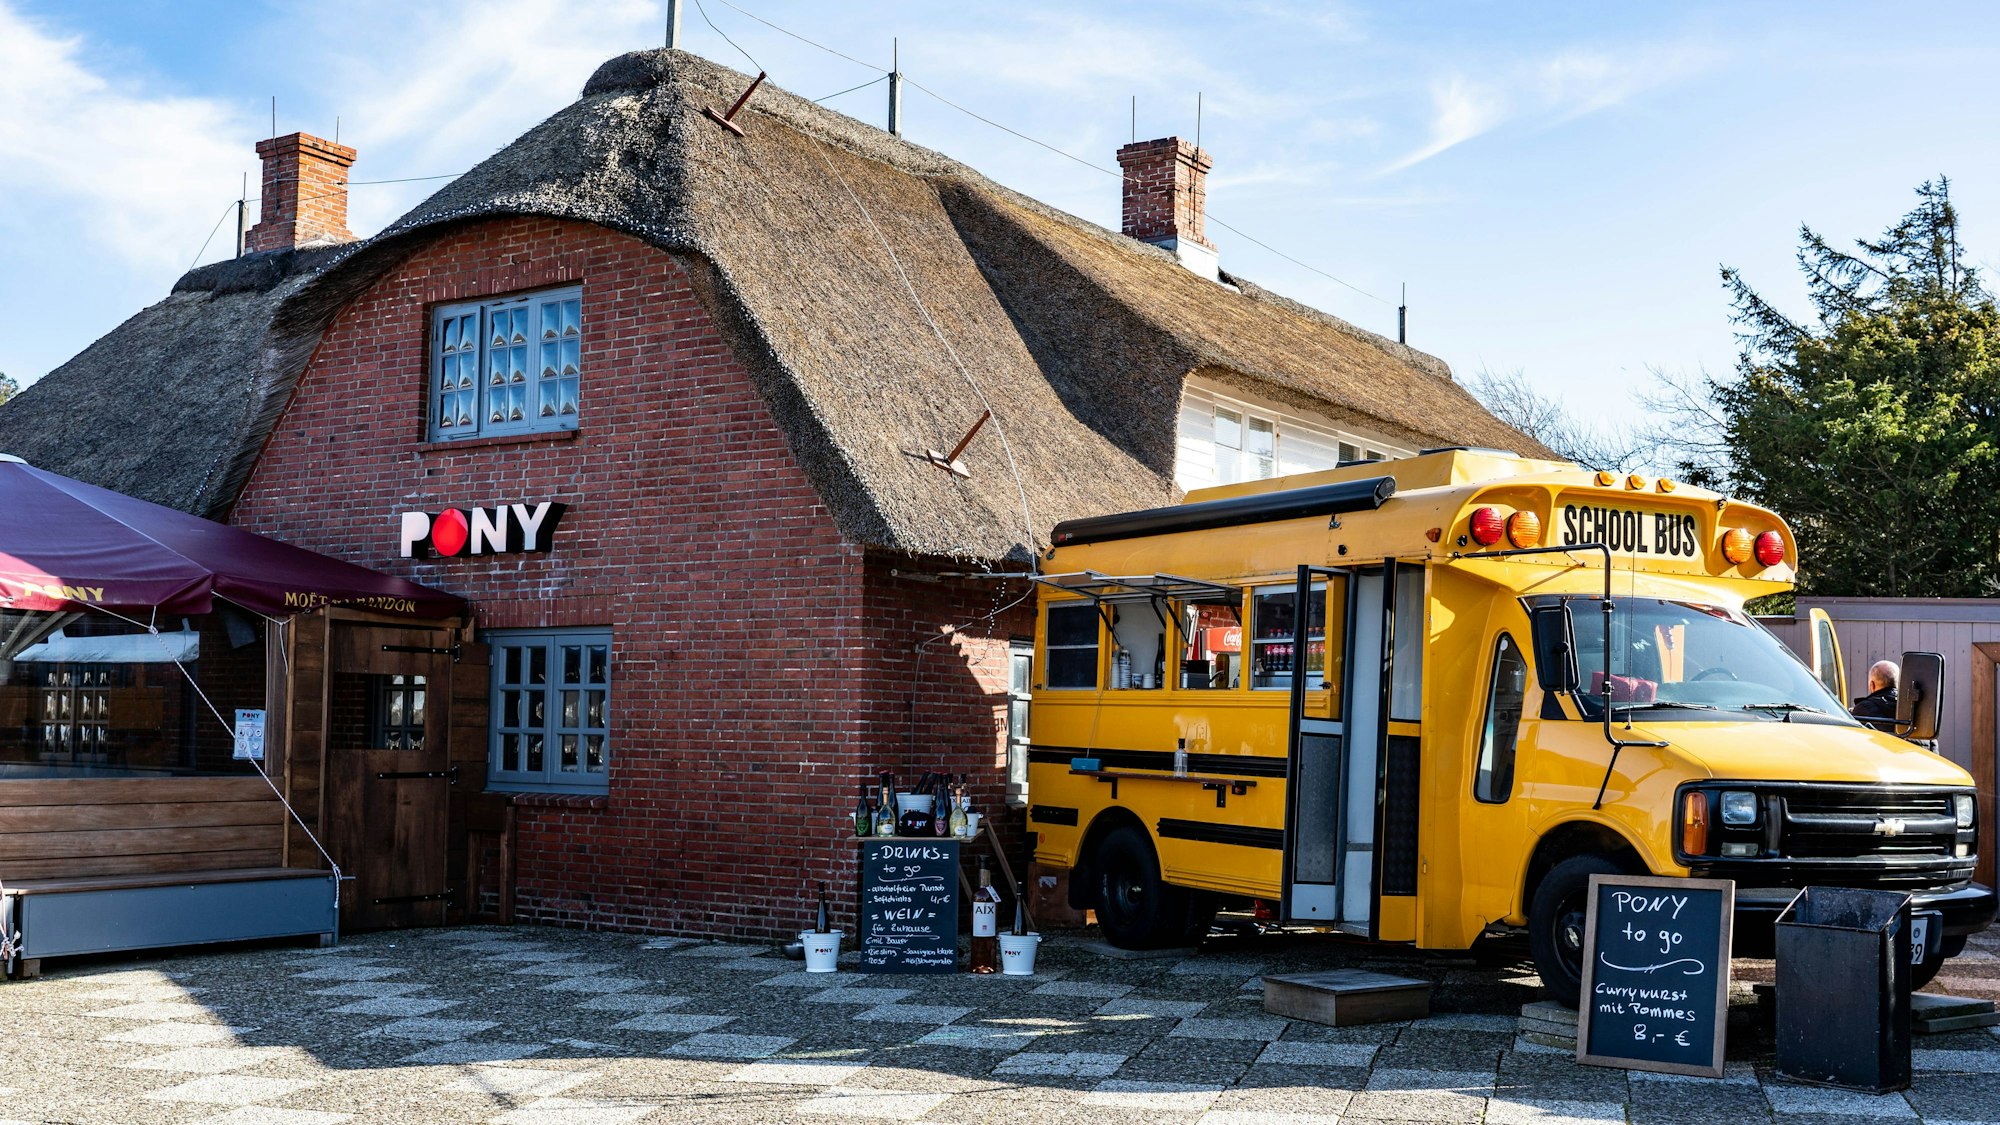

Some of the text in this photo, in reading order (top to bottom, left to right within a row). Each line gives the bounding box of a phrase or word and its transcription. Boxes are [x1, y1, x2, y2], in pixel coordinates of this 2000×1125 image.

[400, 501, 552, 558] PONY
[1564, 504, 1695, 557] SCHOOL BUS
[23, 581, 104, 602] PONY
[285, 591, 328, 608] MOËT
[907, 819, 927, 827] PONY
[880, 845, 941, 860] DRINKS
[882, 863, 921, 878] to go
[919, 883, 945, 892] Punsch
[873, 895, 912, 904] Softdrinks
[1612, 891, 1688, 920] PONY
[884, 907, 924, 921] WEIN
[871, 923, 932, 934] für Zuhause
[1622, 921, 1683, 954] to go
[1599, 1002, 1696, 1022] mit Pommes
